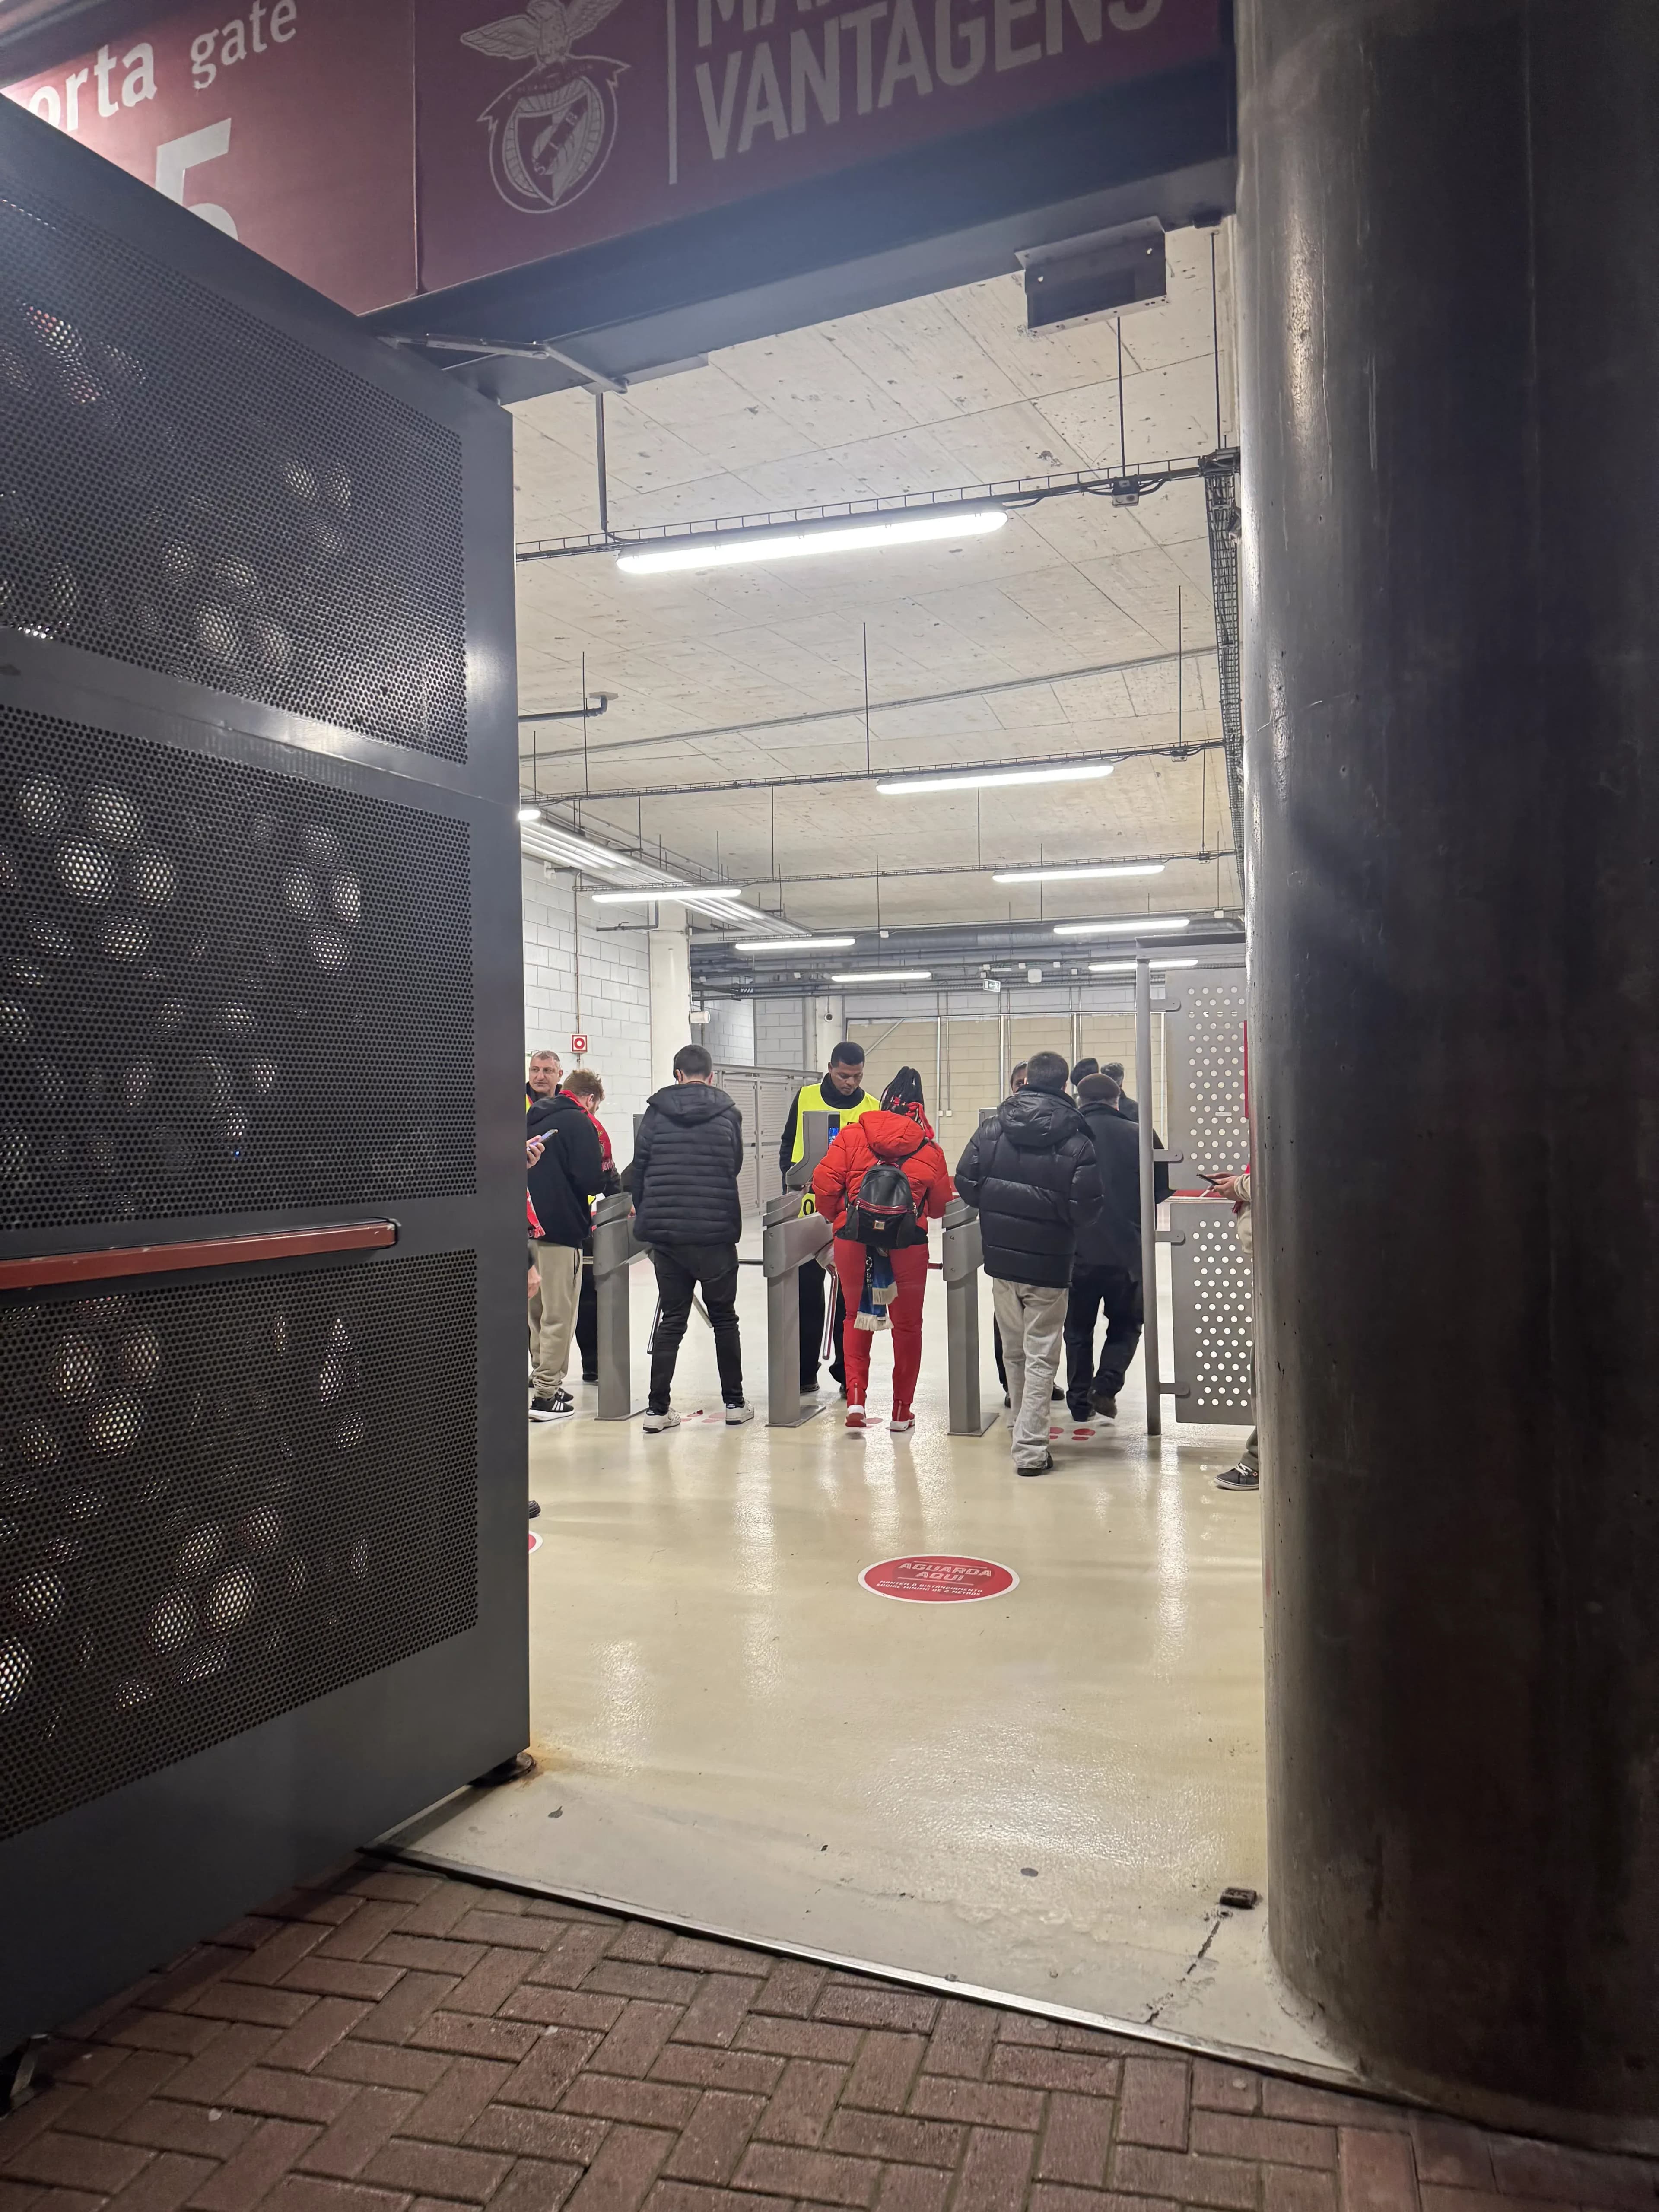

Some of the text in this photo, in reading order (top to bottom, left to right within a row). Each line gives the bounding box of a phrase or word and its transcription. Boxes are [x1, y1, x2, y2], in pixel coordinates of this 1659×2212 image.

[28, 0, 297, 131] orta gate
[156, 118, 238, 241] 5
[898, 1563, 991, 1576] AGUARDA
[915, 1572, 964, 1581] AQUI
